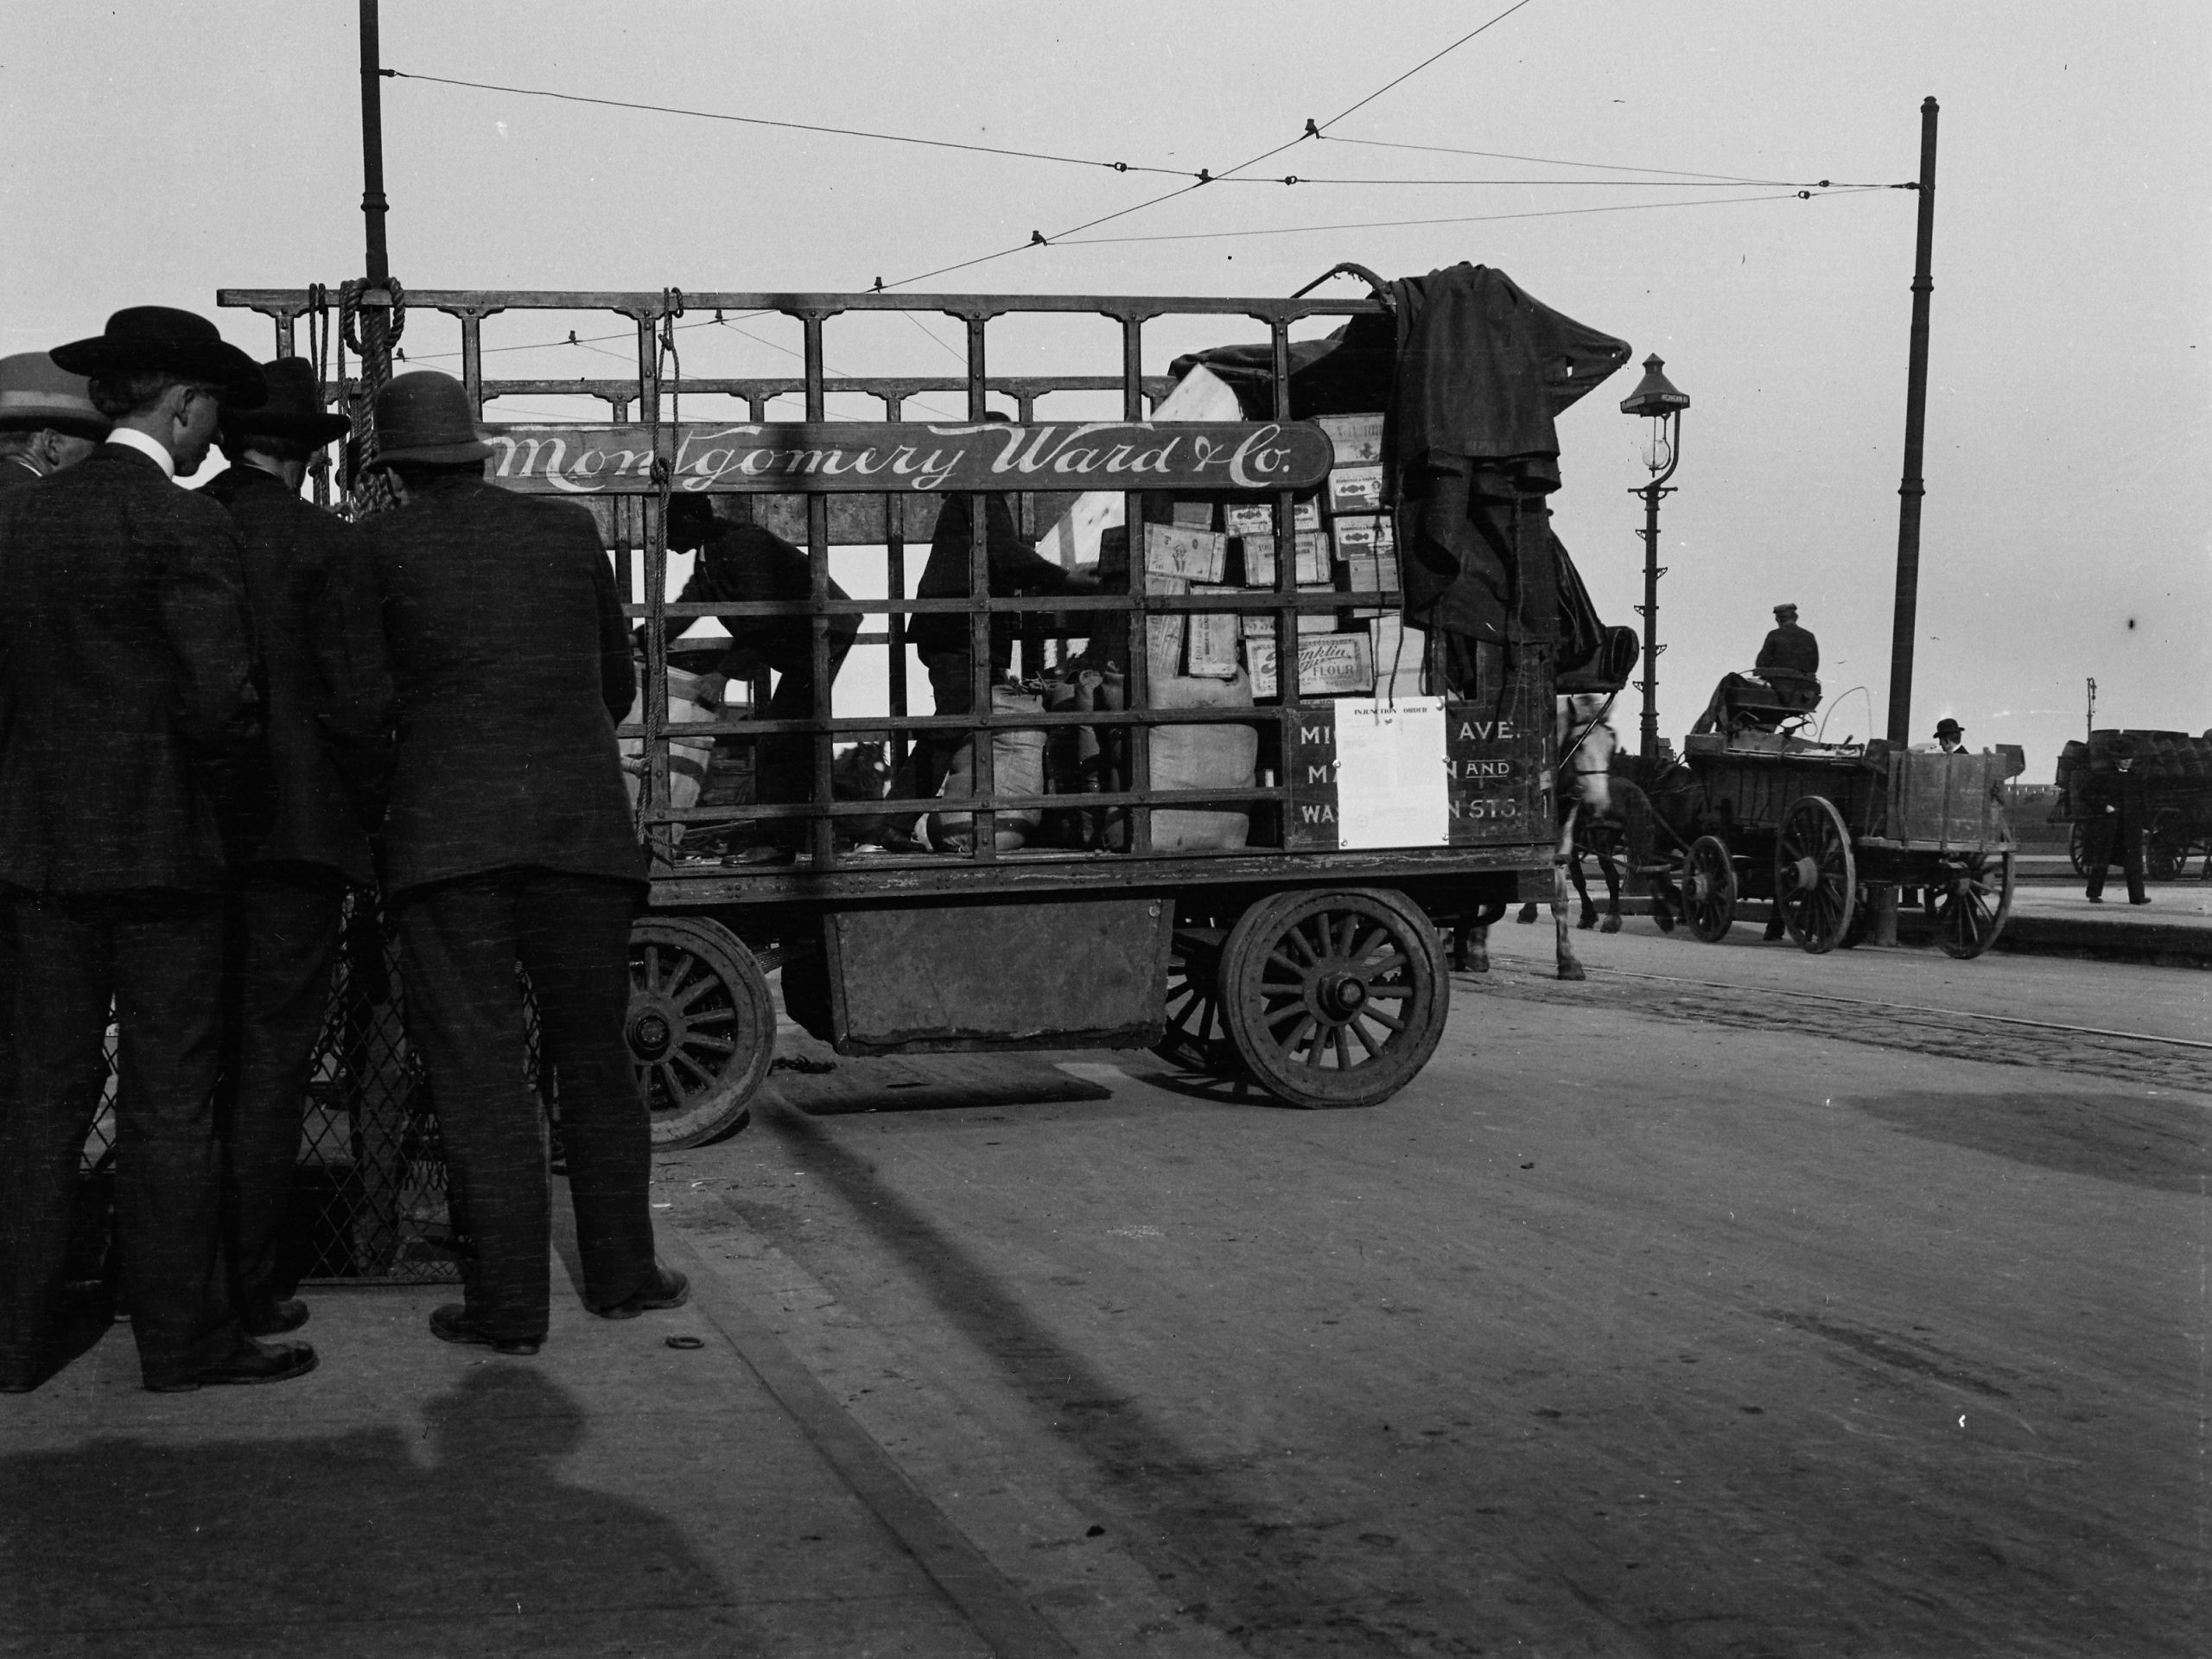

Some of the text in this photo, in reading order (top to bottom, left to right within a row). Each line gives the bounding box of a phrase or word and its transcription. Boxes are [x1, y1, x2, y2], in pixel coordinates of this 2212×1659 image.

[481, 425, 965, 491] Montgomery
[928, 423, 1181, 474] Ward
[1229, 423, 1291, 488] Co.
[1313, 664, 1354, 677] FLOUR
[1459, 721, 1522, 741] AVE.
[1466, 762, 1510, 775] AND
